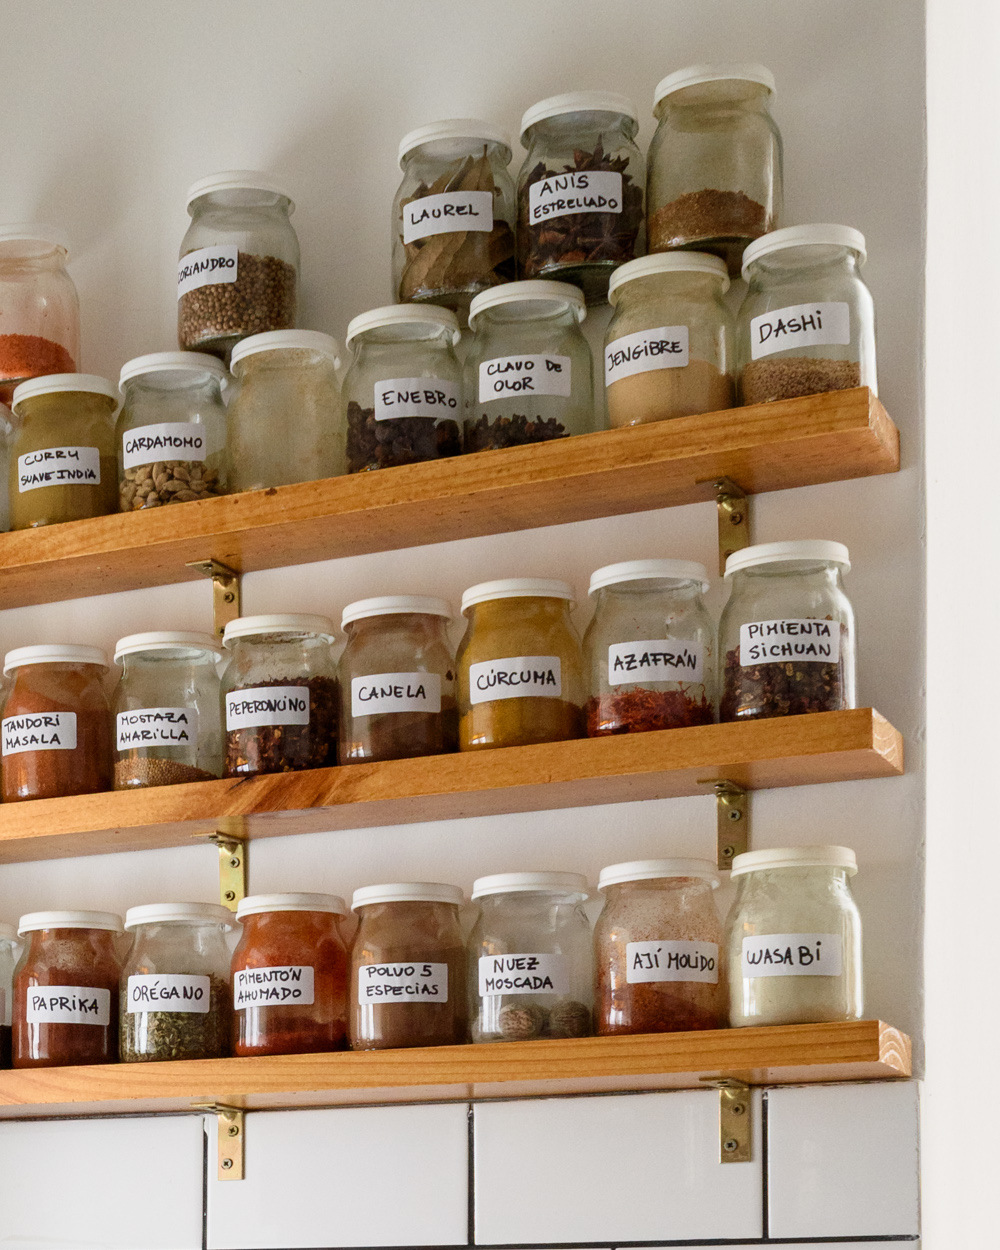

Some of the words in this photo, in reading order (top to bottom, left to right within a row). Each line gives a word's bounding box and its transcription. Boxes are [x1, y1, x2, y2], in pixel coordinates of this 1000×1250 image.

[411, 204, 480, 225] LAUREL
[532, 196, 619, 219] ESTRELLADO
[758, 310, 824, 345] DASHI
[607, 340, 683, 372] JENGIBRE
[486, 360, 535, 376] CLAVO
[545, 359, 563, 374] DE
[493, 377, 535, 392] OLOR
[382, 389, 458, 408] ENEBRO
[125, 436, 203, 454] CARDAMOMO
[23, 450, 81, 466] CURRY
[747, 621, 832, 640] PIMIENTA
[747, 640, 832, 661] SICHUAN
[613, 647, 697, 673] AZAFRÁN
[357, 684, 428, 702] CANELA
[3, 714, 61, 733] TANDORI
[121, 712, 189, 726] MOSTAZA
[5, 734, 62, 750] MASALA
[119, 728, 189, 743] AMARILLA
[492, 956, 540, 973] NUEZ
[632, 947, 663, 970] AJÍ
[666, 950, 715, 971] MOLIDO
[238, 967, 302, 985] PIMENTÓN
[366, 965, 416, 979] POLVO
[420, 964, 433, 977] 5
[132, 980, 204, 1001] ORÉGANO
[366, 982, 440, 998] ESPECIAS
[484, 975, 553, 992] MOSCADA
[237, 986, 302, 1004] AHUMADO
[32, 994, 99, 1015] PAPRIKA
